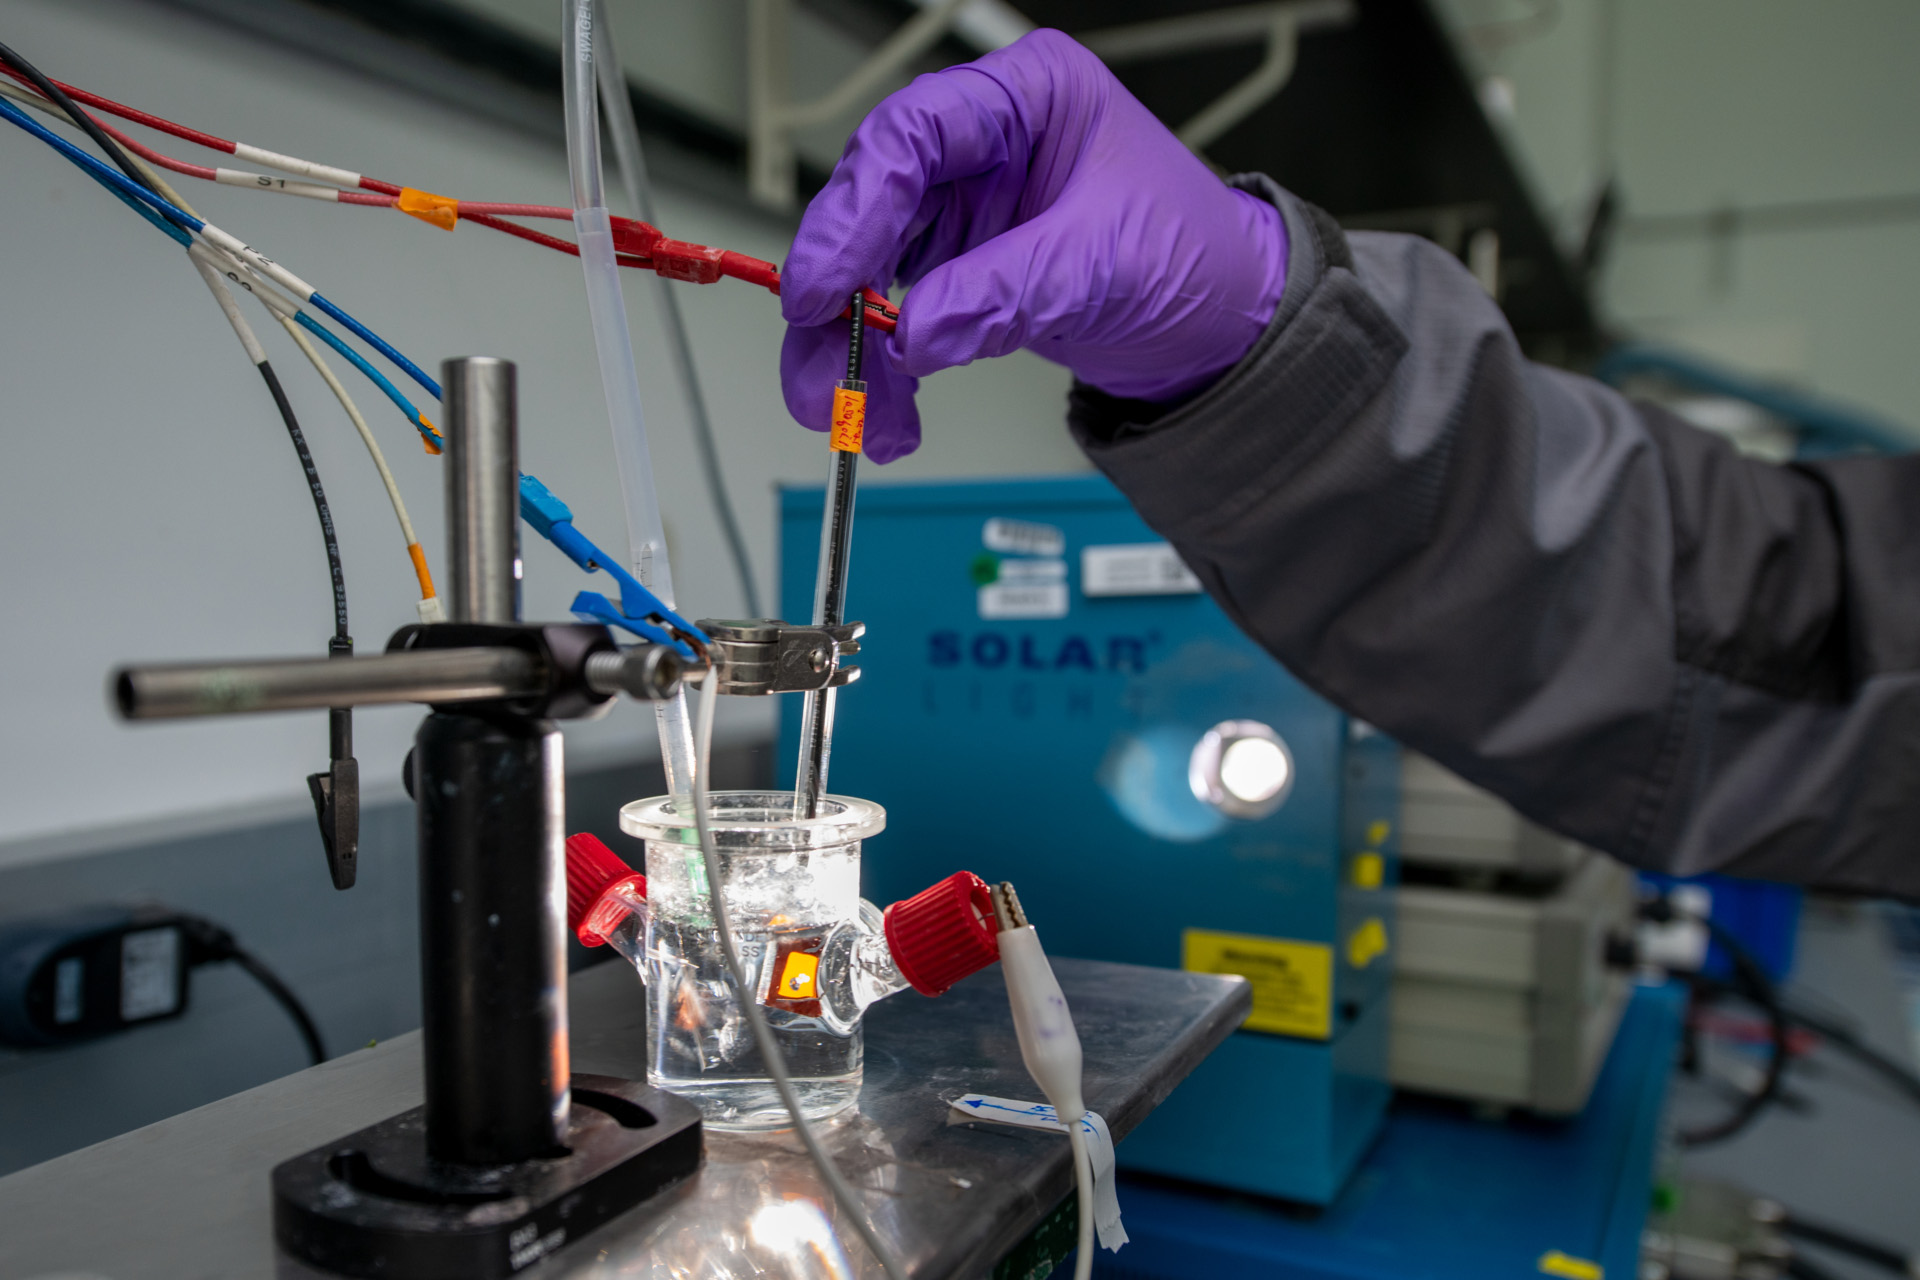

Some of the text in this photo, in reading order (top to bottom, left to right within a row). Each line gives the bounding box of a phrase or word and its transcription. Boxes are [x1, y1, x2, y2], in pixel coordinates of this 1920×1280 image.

[257, 176, 286, 189] S1
[847, 317, 860, 379] RESISTANT
[292, 429, 304, 445] KX
[320, 504, 334, 535] OHMS
[929, 632, 1148, 672] SOLAR
